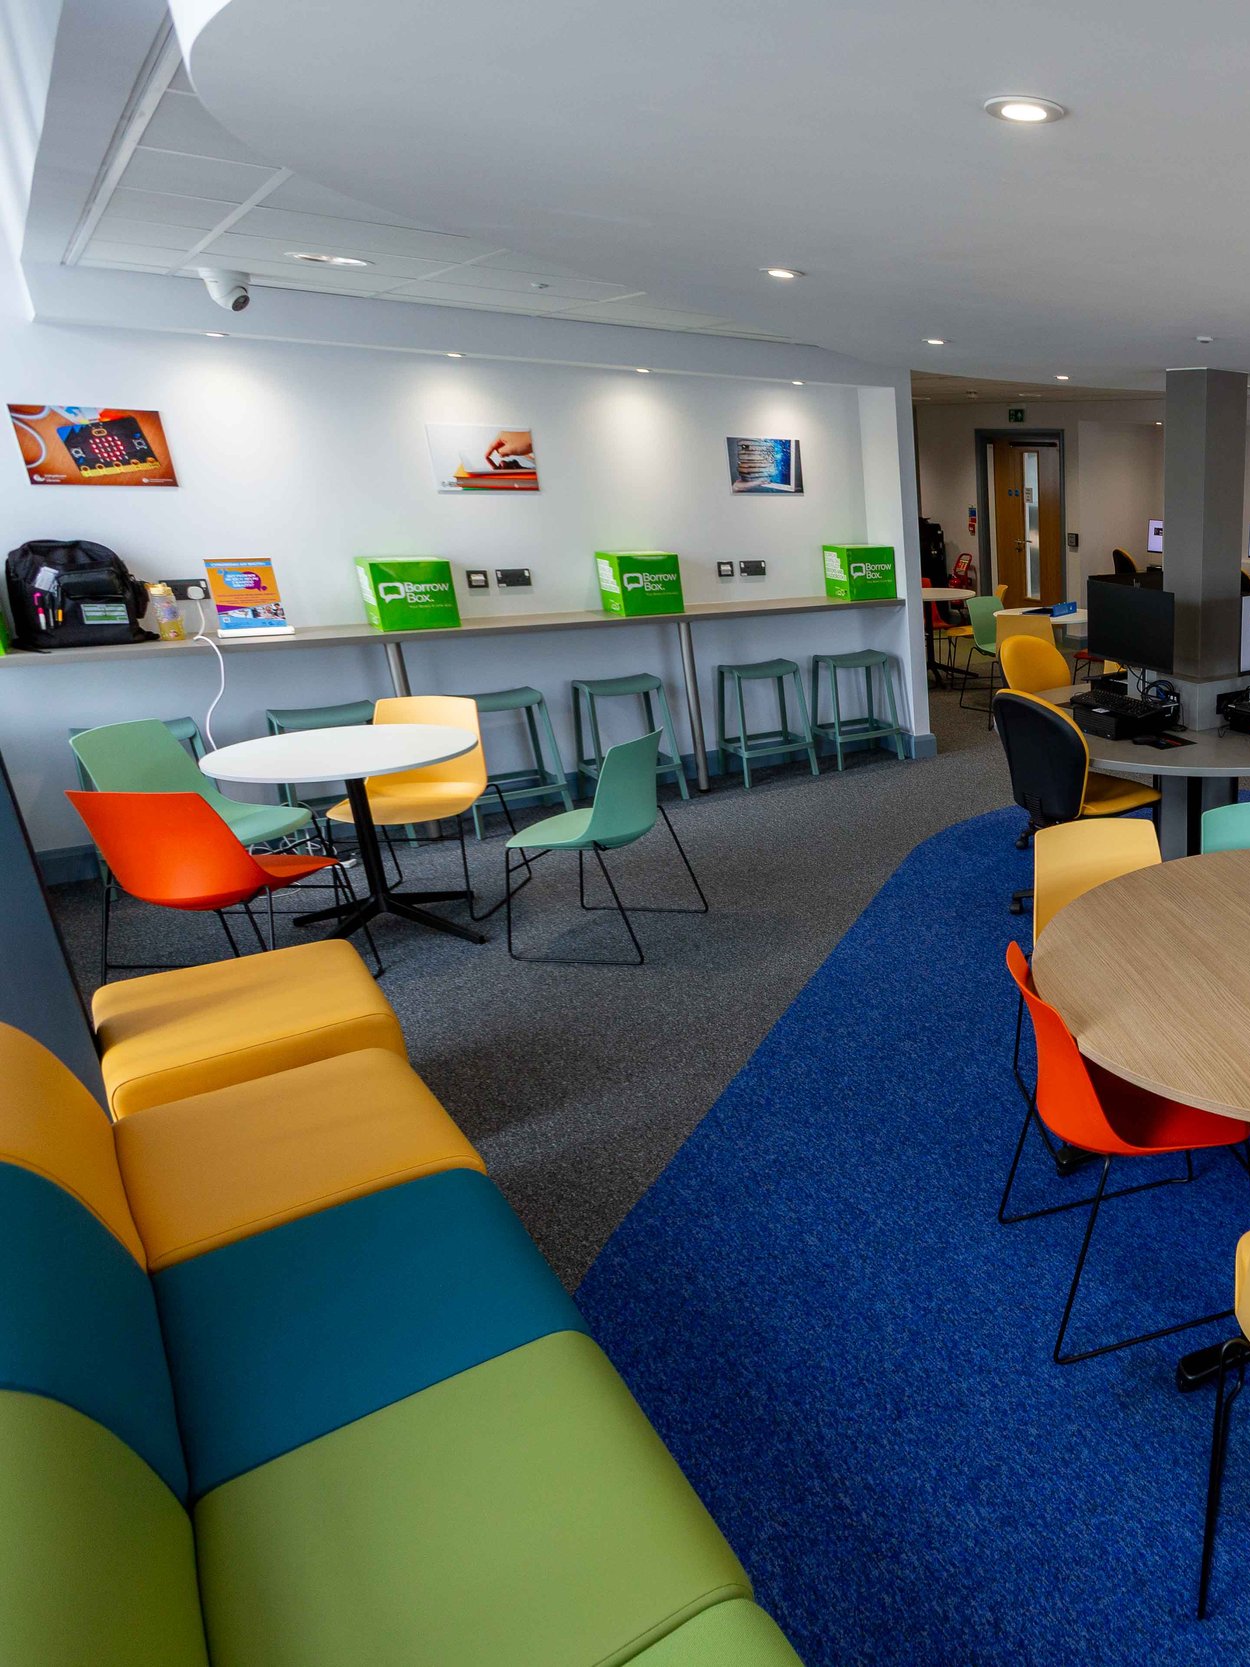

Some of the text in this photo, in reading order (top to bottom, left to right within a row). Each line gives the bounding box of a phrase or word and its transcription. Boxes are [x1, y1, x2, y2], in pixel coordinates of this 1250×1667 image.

[865, 562, 892, 571] Borrow
[642, 572, 677, 582] Borrow
[403, 582, 449, 592] Borrow
